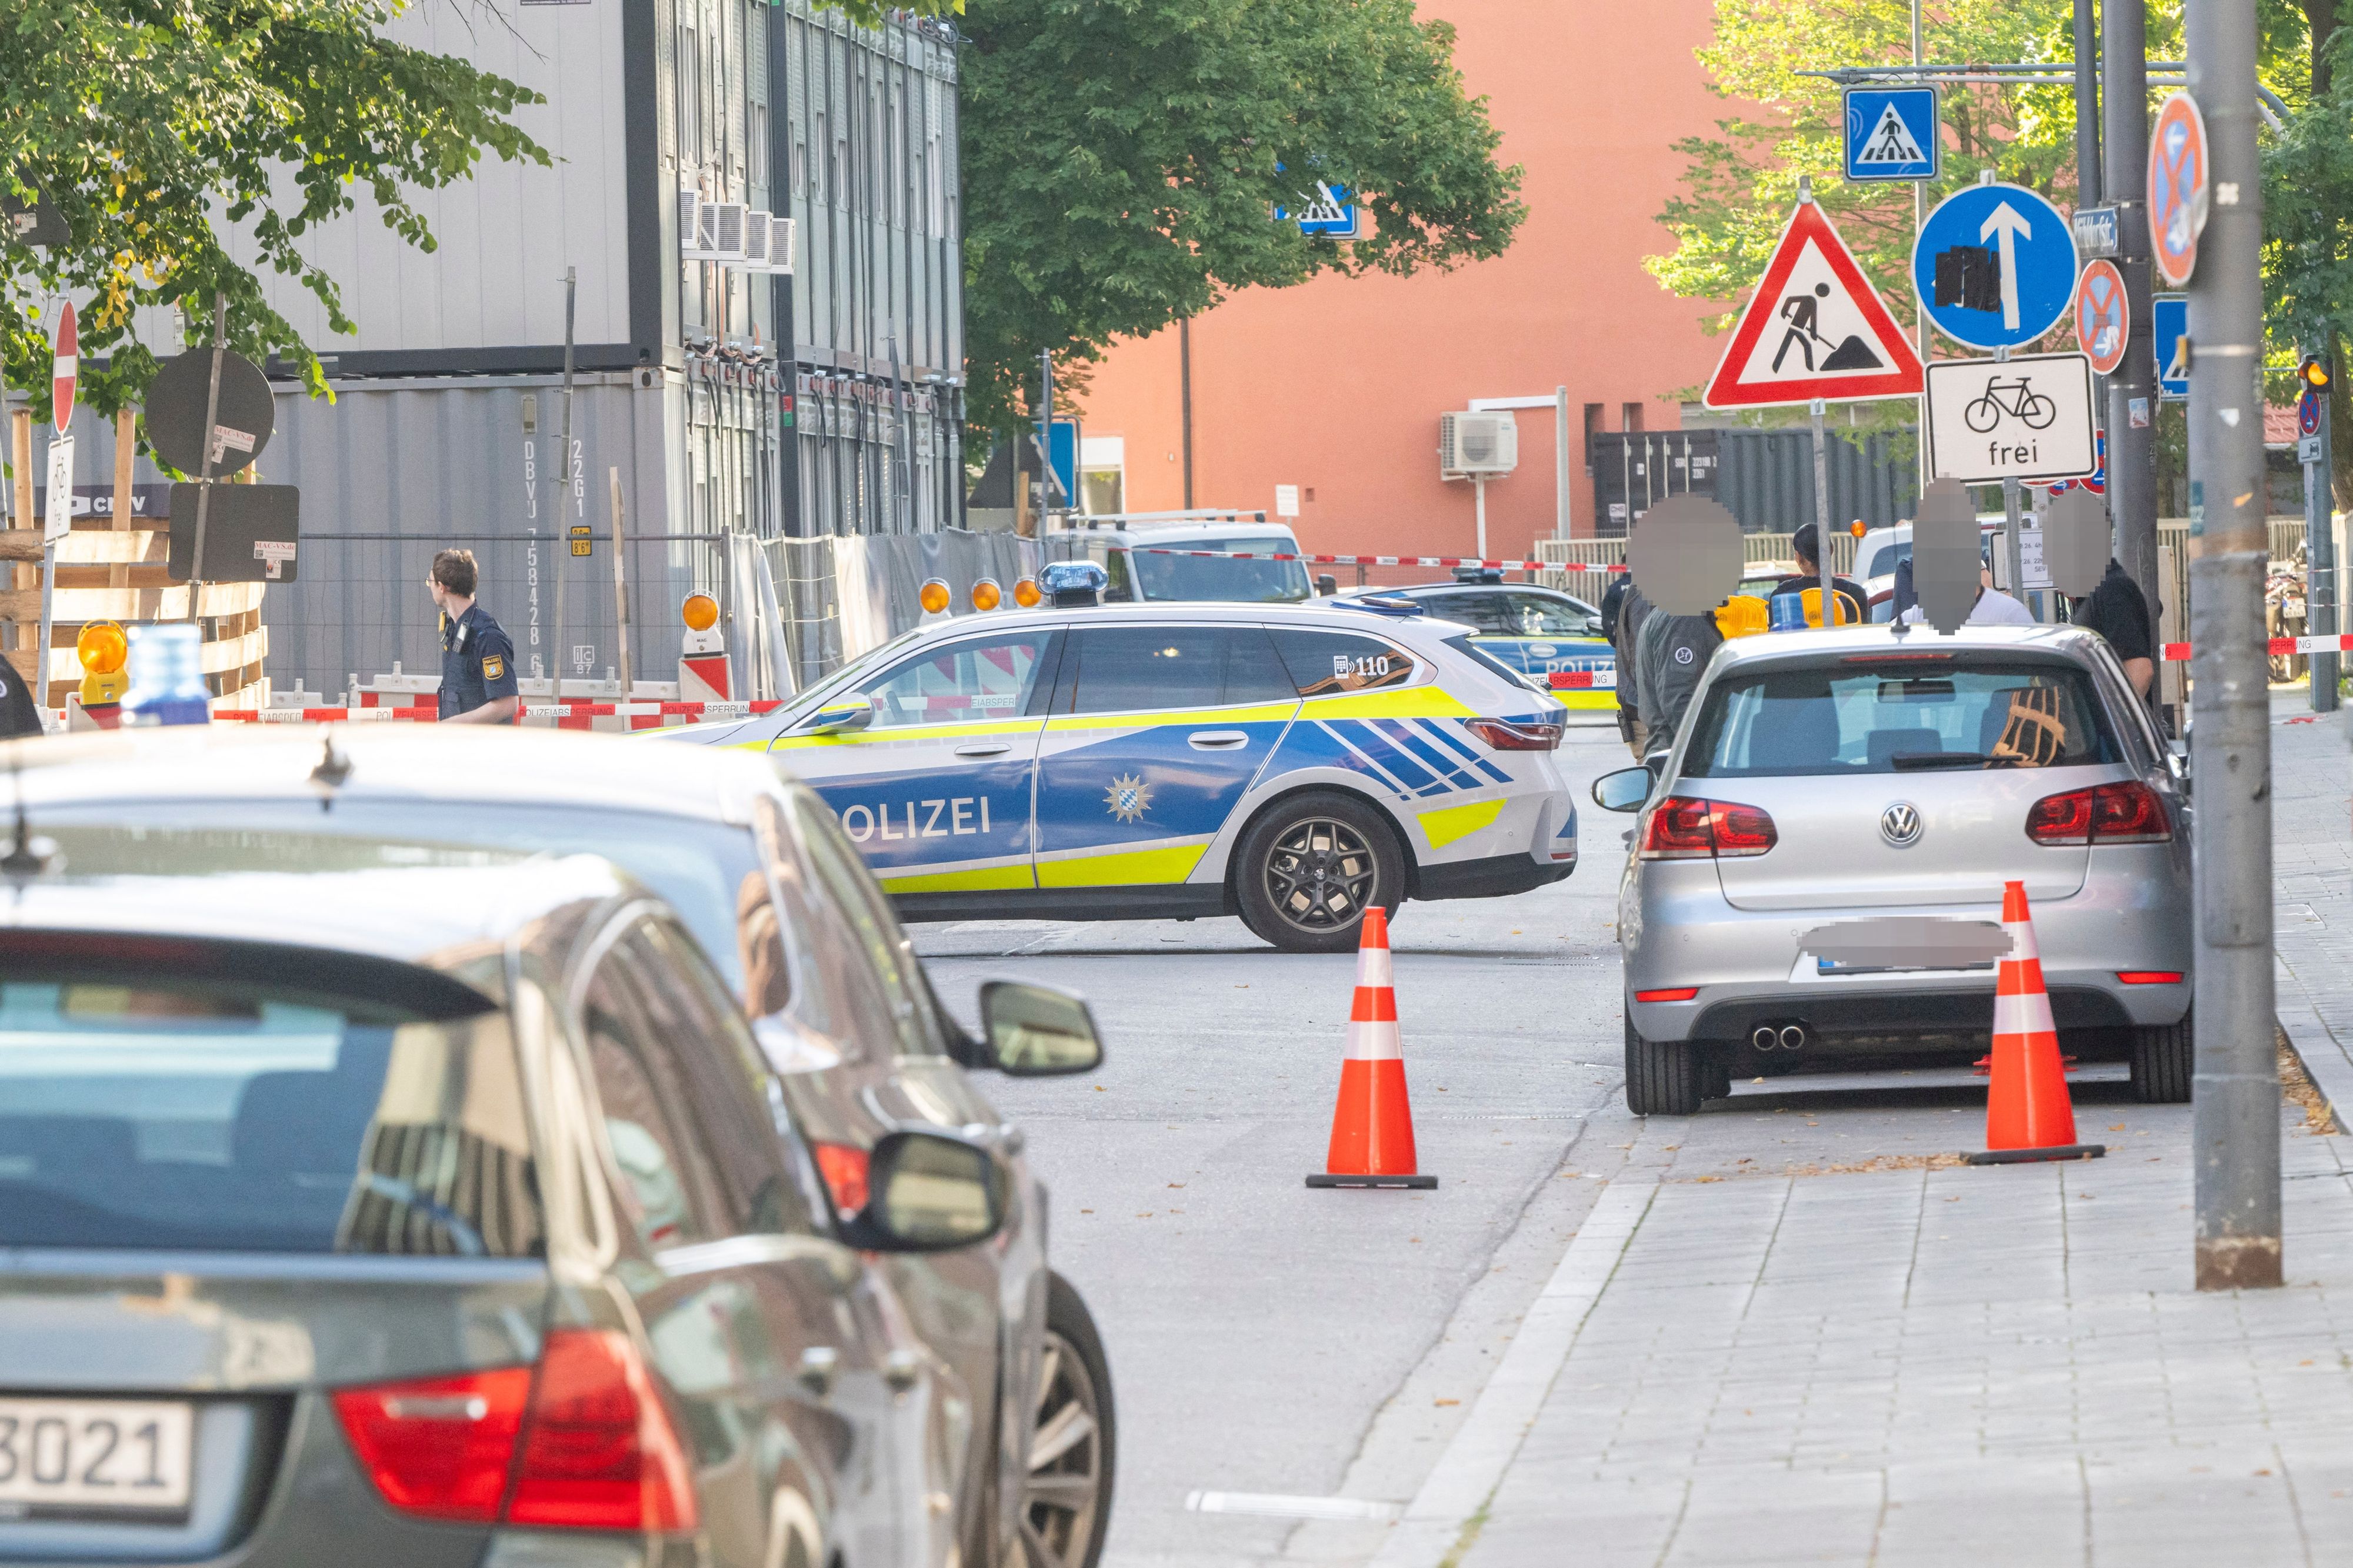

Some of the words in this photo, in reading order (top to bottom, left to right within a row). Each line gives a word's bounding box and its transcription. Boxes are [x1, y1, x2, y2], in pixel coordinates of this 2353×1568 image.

[1989, 438, 2037, 465] frei
[573, 440, 584, 517] 22G1
[1357, 656, 1388, 676] 110
[1546, 660, 1615, 674] POLIZ
[520, 708, 612, 717] POLIZEIABSPERRUNG
[663, 705, 755, 714] POLIZEIABSPERRUNG
[838, 796, 990, 843] OLIZEI
